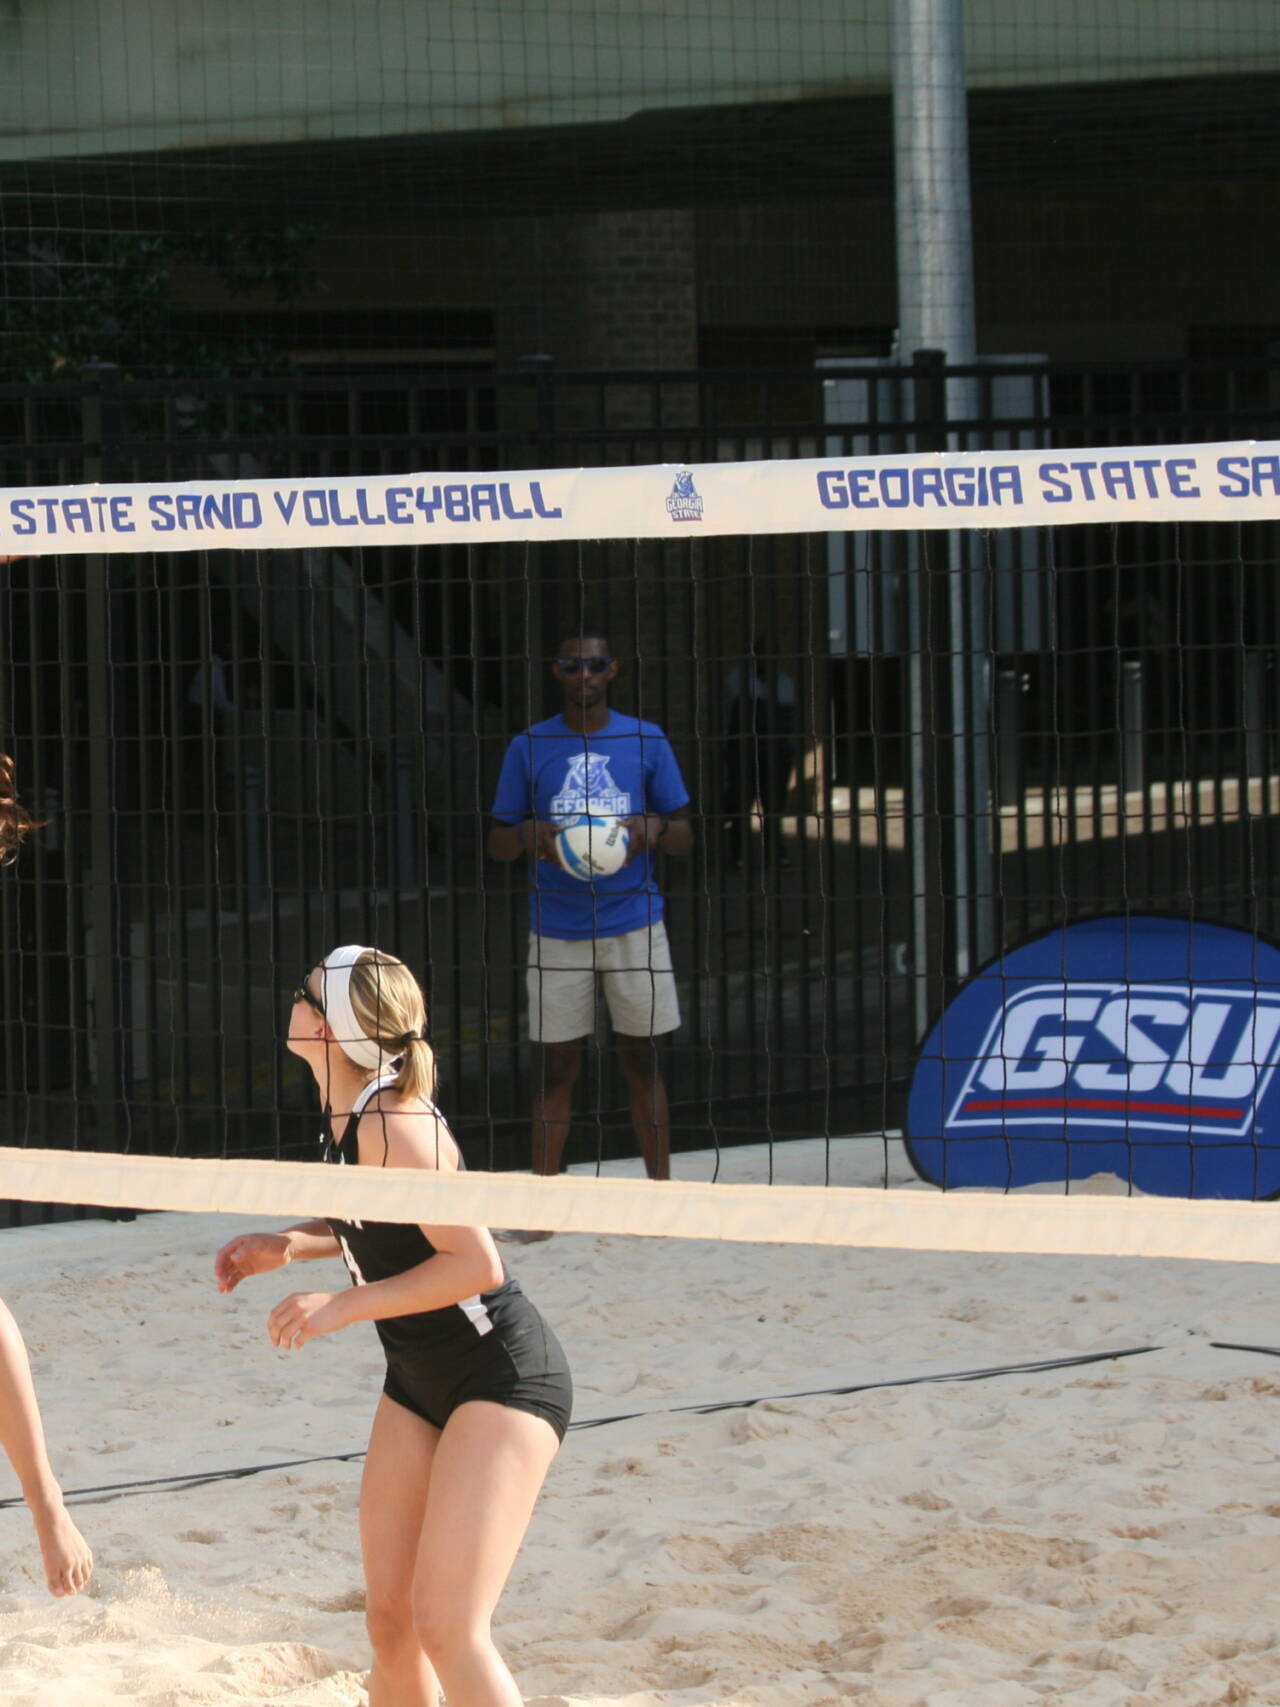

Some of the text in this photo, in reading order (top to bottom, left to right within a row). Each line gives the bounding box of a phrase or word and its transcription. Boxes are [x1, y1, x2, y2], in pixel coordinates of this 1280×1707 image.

[10, 496, 136, 535] STATE
[148, 491, 263, 532] SAND
[273, 481, 562, 527] VOLLEYBALL
[666, 496, 704, 512] GEORGIA
[817, 464, 1024, 510] GEORGIA
[1039, 457, 1201, 503] STATE
[978, 997, 1280, 1100] GSU
